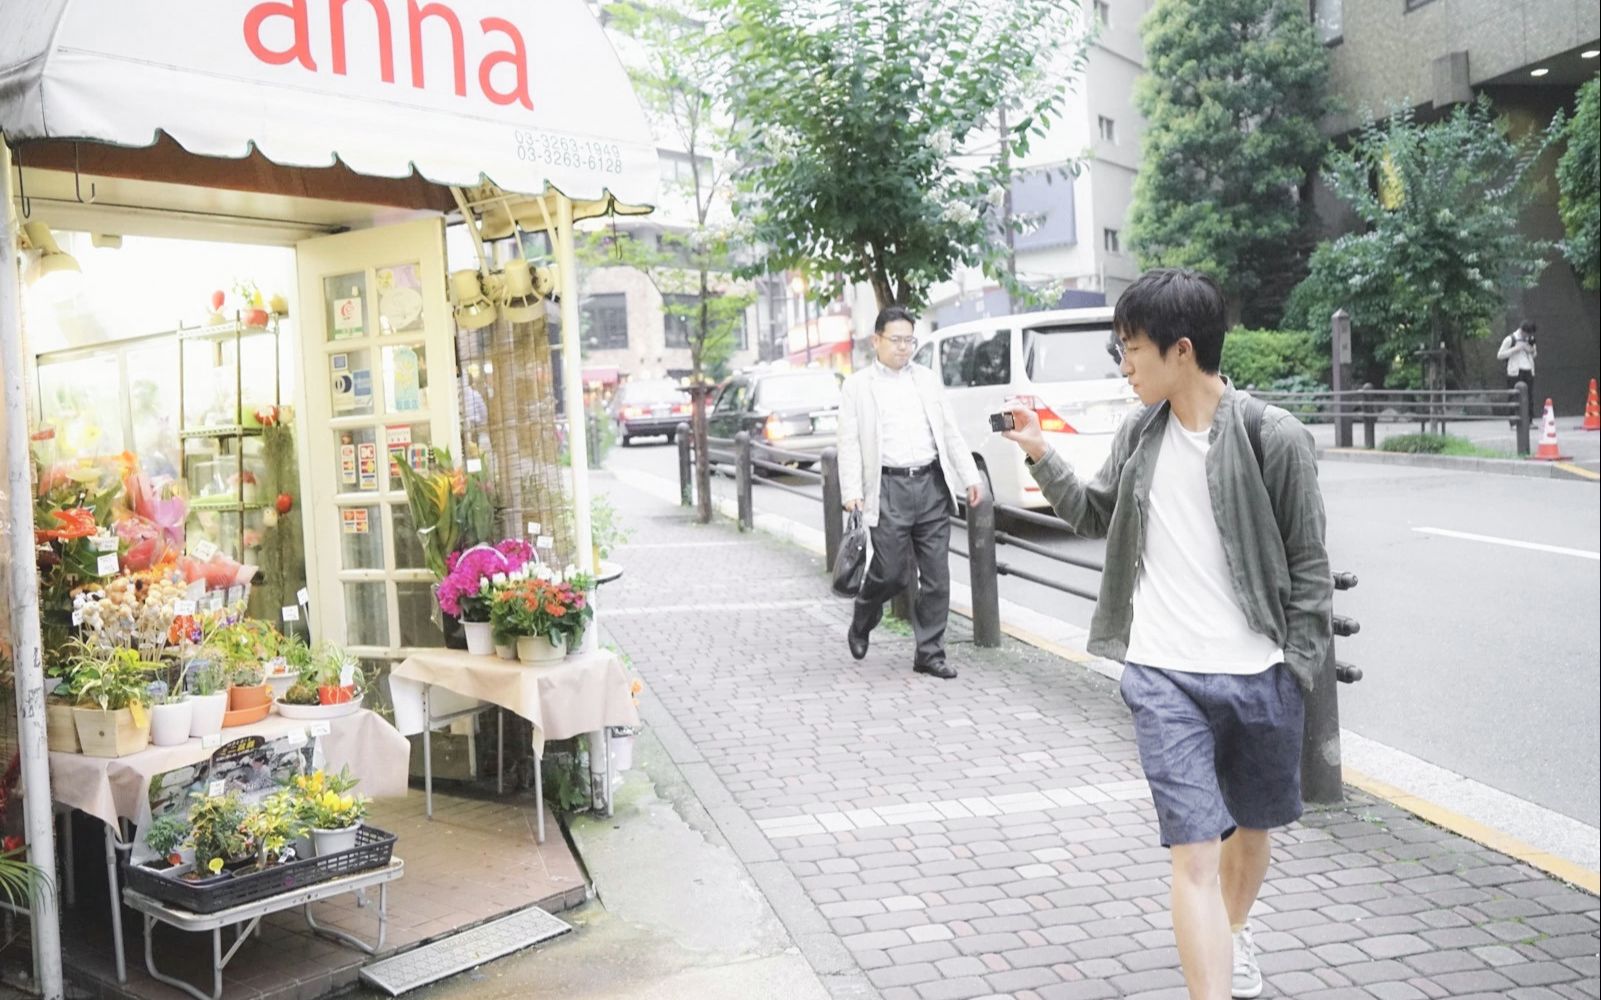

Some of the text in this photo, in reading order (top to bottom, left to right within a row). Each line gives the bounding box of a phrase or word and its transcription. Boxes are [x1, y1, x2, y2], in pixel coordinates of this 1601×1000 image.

[243, 0, 534, 111] anna
[514, 129, 621, 158] 03-3263-1949
[517, 144, 623, 174] 03-3263-6128
